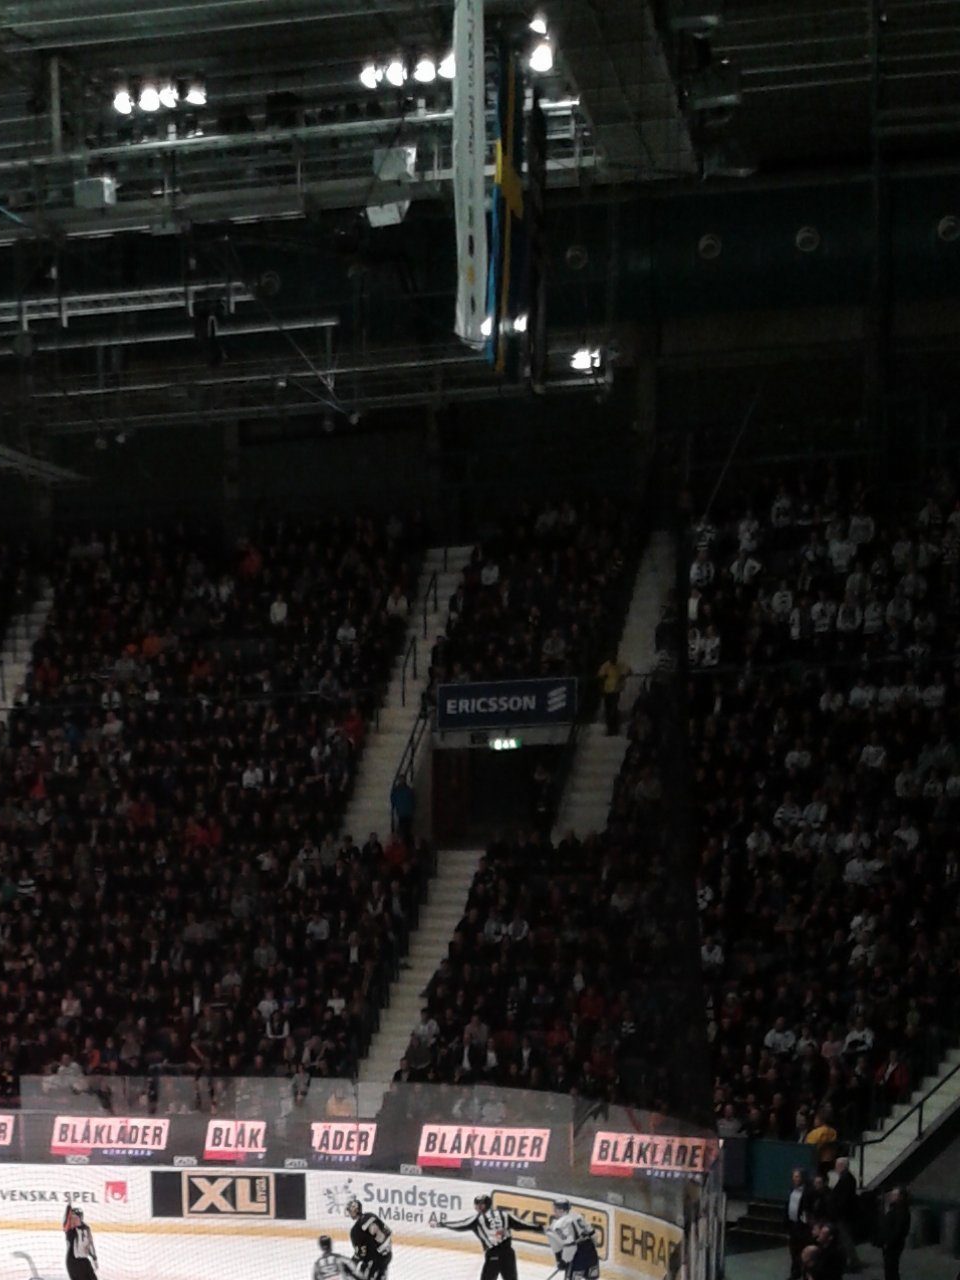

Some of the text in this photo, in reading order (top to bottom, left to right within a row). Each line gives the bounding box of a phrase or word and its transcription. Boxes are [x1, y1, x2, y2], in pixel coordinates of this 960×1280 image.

[446, 695, 536, 715] ERICSSON
[58, 1118, 165, 1146] BLÅKLÄDER
[424, 1128, 544, 1159] BLÅKLÄDER
[62, 1190, 100, 1205] SPEL
[189, 1177, 267, 1213] XL
[363, 1182, 463, 1211] Sundsten
[378, 1205, 424, 1223] Måleri
